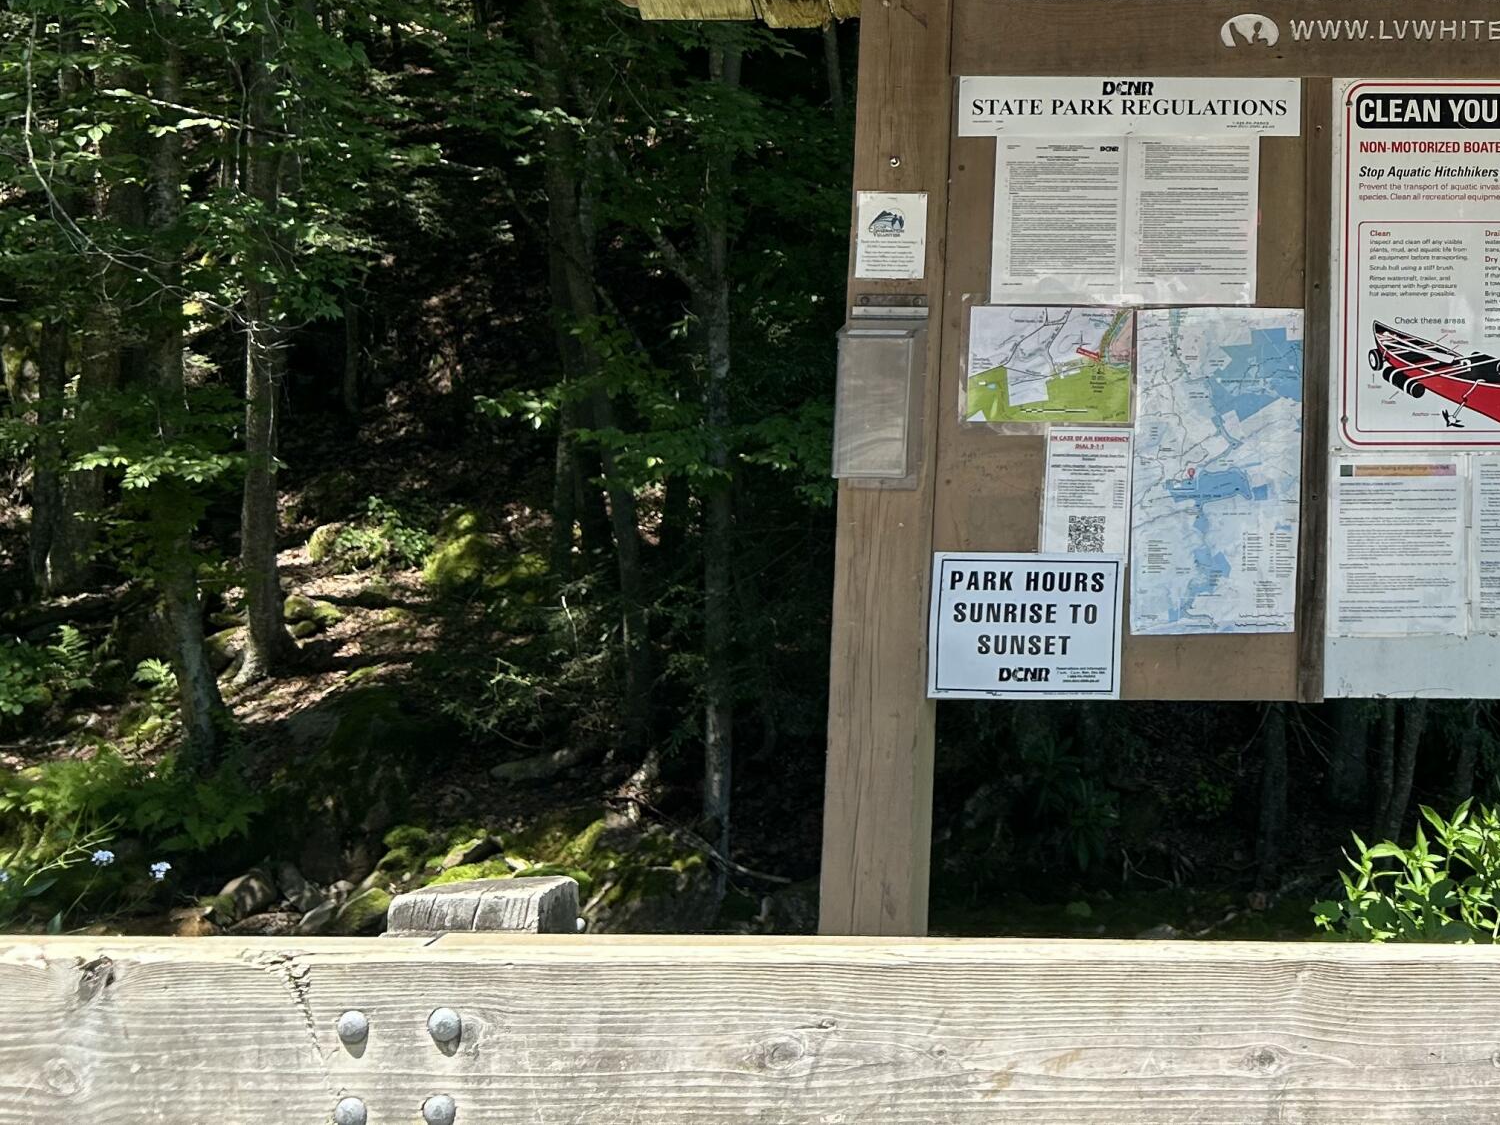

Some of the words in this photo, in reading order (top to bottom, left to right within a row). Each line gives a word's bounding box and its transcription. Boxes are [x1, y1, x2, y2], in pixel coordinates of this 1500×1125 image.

[1102, 81, 1154, 95] DCNR
[972, 99, 1042, 115] STATE
[1052, 100, 1112, 115] PARK
[1122, 99, 1286, 115] REGULATIONS
[1360, 99, 1440, 122] CLEAN
[1360, 141, 1460, 153] NON-MOTORIZED
[1359, 166, 1384, 179] Stop
[1387, 166, 1431, 179] Aquatic
[950, 571, 1013, 591] PARK
[1026, 572, 1104, 592] HOURS
[954, 603, 1057, 623] SUNRISE
[1069, 604, 1097, 624] TO
[978, 635, 1070, 655] SUNSET
[999, 667, 1050, 682] DCNR
